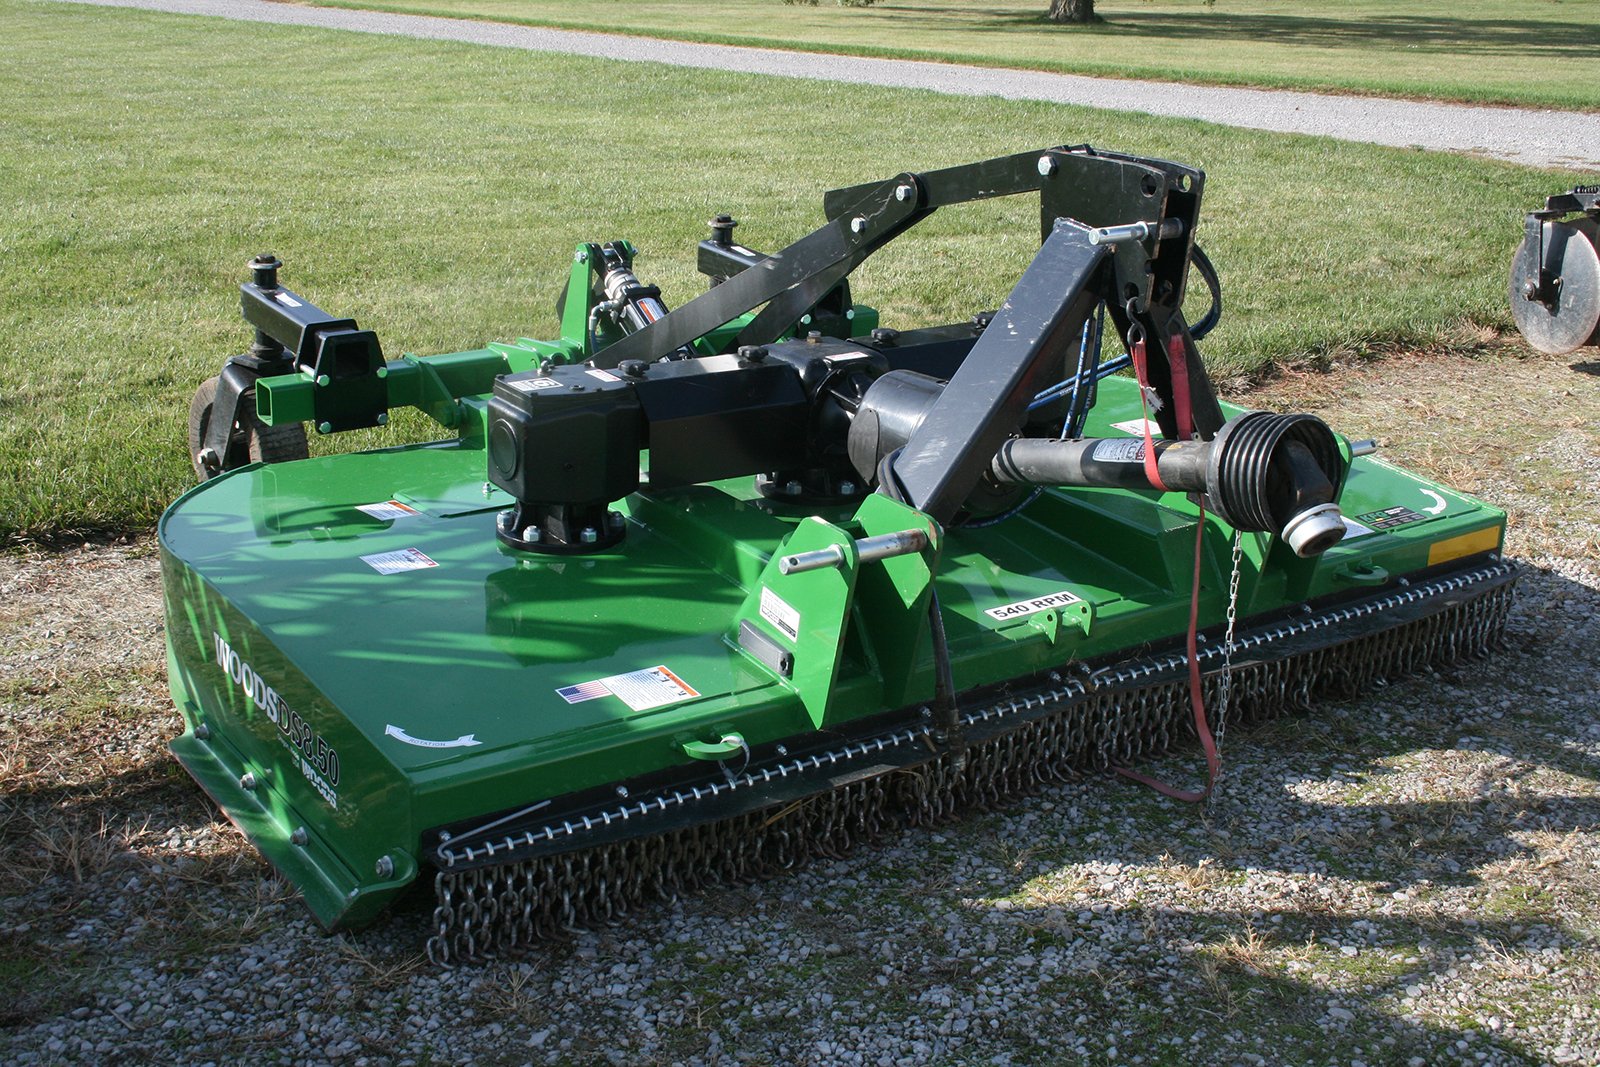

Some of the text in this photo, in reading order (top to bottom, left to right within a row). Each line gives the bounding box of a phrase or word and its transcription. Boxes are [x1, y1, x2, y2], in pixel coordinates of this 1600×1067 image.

[993, 593, 1075, 617] 540 RPM
[213, 631, 278, 723] WOODS
[408, 738, 446, 747] ROTATION
